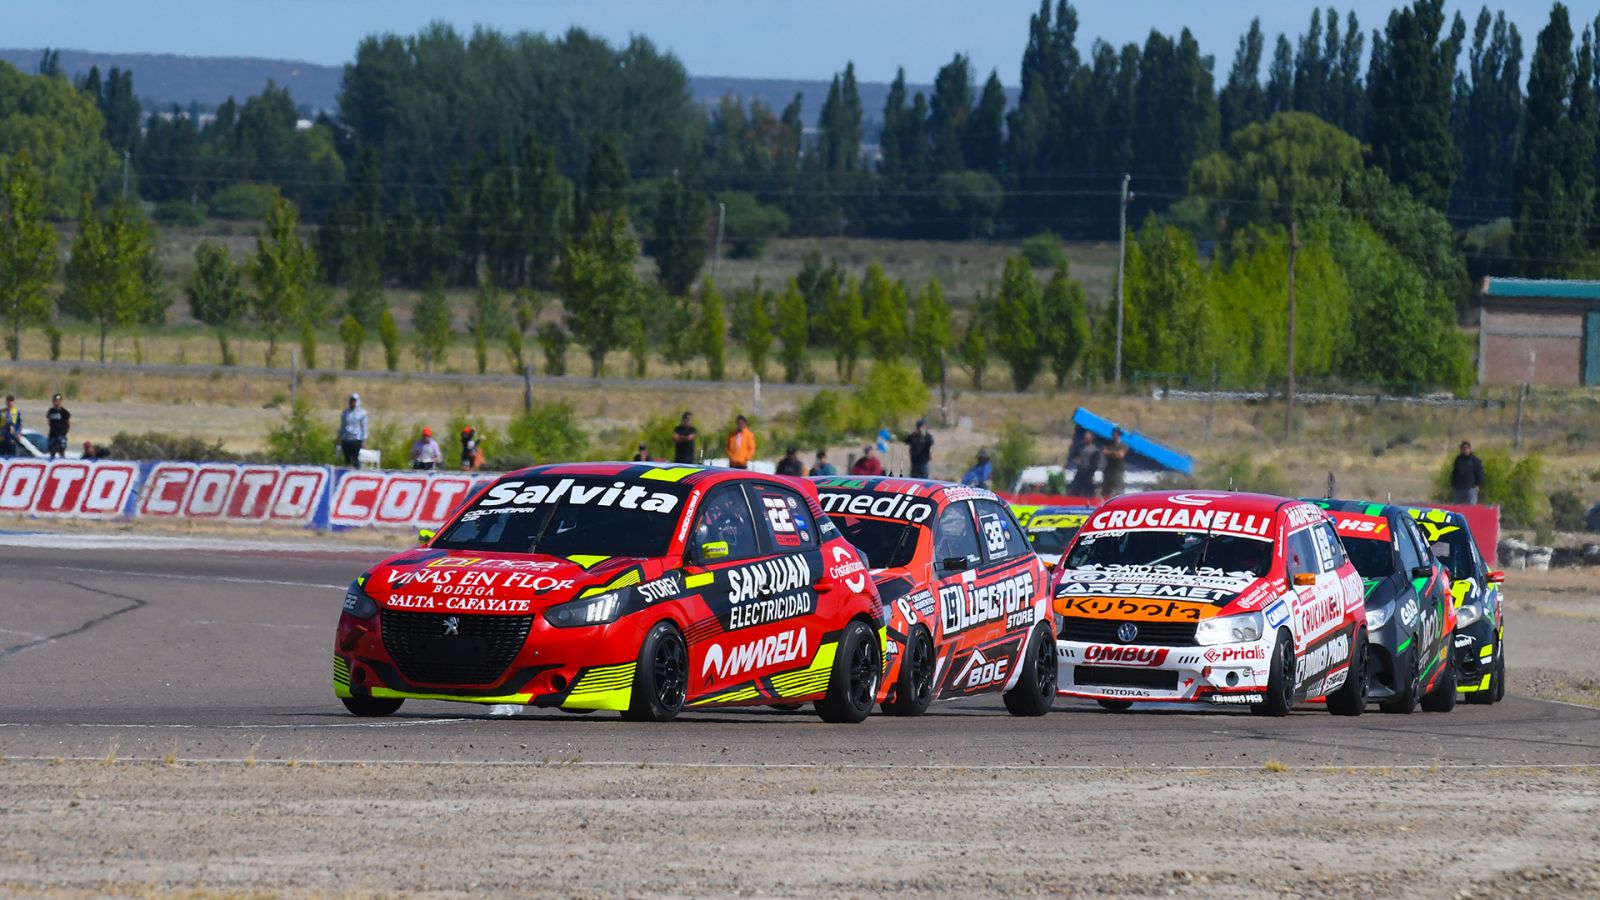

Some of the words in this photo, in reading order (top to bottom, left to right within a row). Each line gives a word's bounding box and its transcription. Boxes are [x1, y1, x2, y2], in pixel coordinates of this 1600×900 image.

[0, 463, 133, 513] OTO
[140, 467, 323, 520] COTO
[332, 475, 497, 523] COT
[479, 479, 678, 514] Salvita
[1092, 508, 1271, 535] CRUCIANELLI
[983, 520, 1005, 552] 38
[432, 585, 495, 597] BODEGA
[459, 570, 501, 587] EN
[503, 571, 575, 592] FLOR
[637, 576, 681, 603] STOREY
[1057, 583, 1237, 601] ARSEMET
[386, 594, 435, 609] SALTA
[445, 597, 531, 612] CAFAYATE
[729, 592, 811, 630] ELECTRICIDAD
[1064, 598, 1200, 619] Kubota
[1006, 608, 1034, 629] STORE
[720, 626, 807, 679] AMARELA
[1222, 645, 1265, 661] Prialis
[967, 658, 1008, 688] BDC
[1101, 688, 1151, 697] TOTORAS
